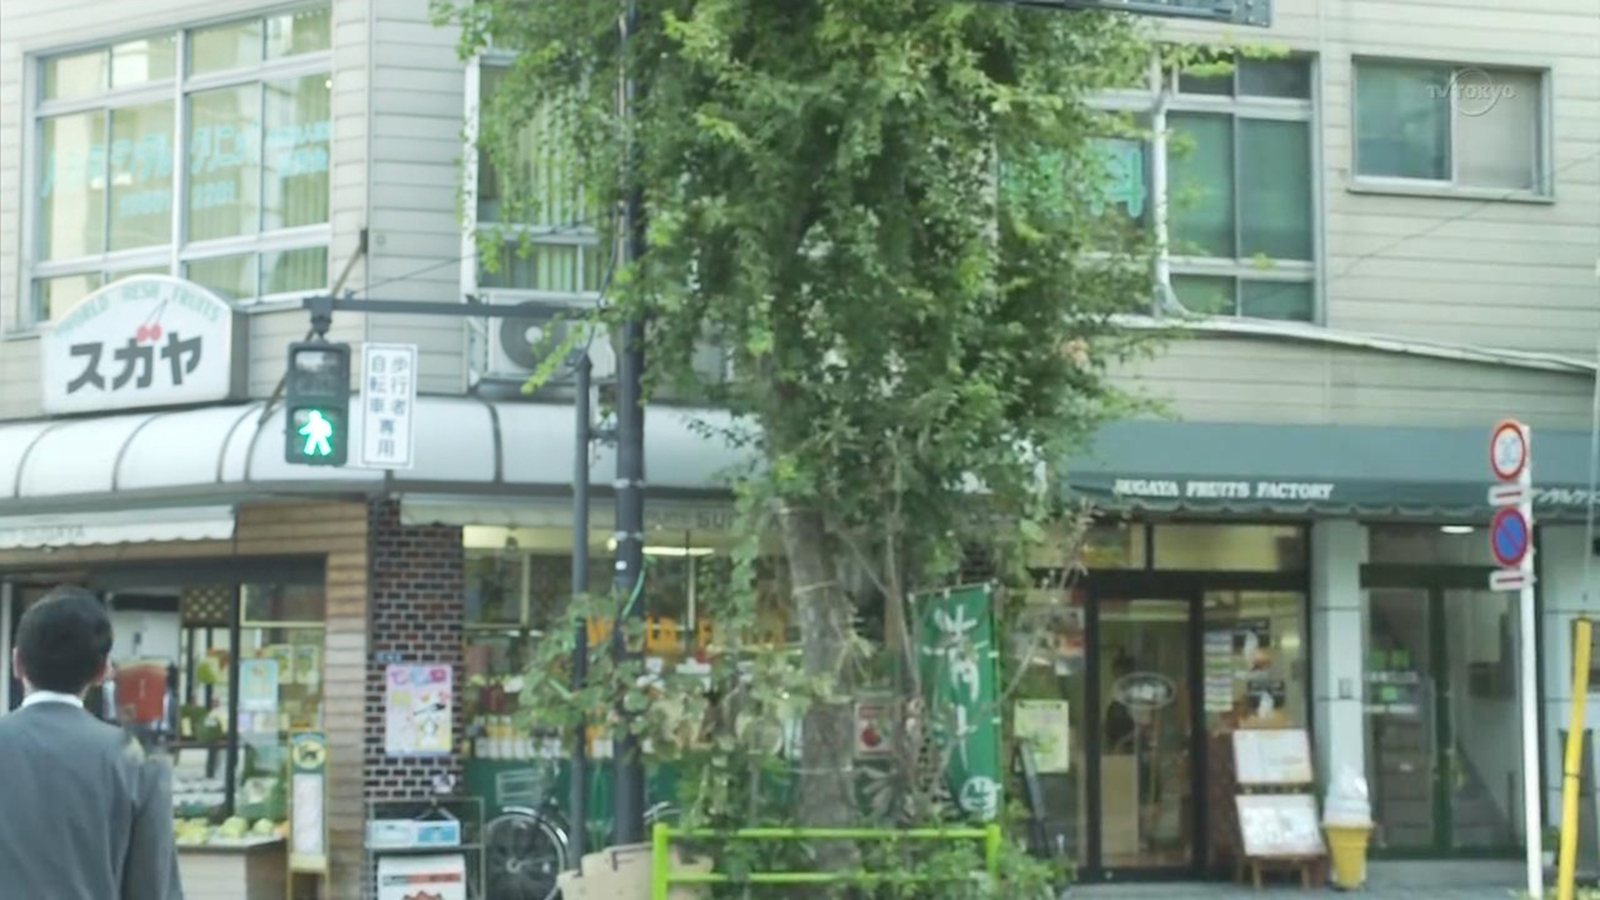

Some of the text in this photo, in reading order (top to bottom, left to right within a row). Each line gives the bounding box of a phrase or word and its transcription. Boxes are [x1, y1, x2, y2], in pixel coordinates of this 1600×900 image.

[116, 281, 161, 301] RESH
[173, 283, 221, 323] FRUITS
[66, 331, 202, 394] スガヤ
[369, 354, 387, 413] 自転車
[391, 355, 409, 416] 歩行者
[378, 418, 395, 458] 専用
[1186, 480, 1251, 498] FRUITS
[1257, 482, 1334, 499] FACTORY
